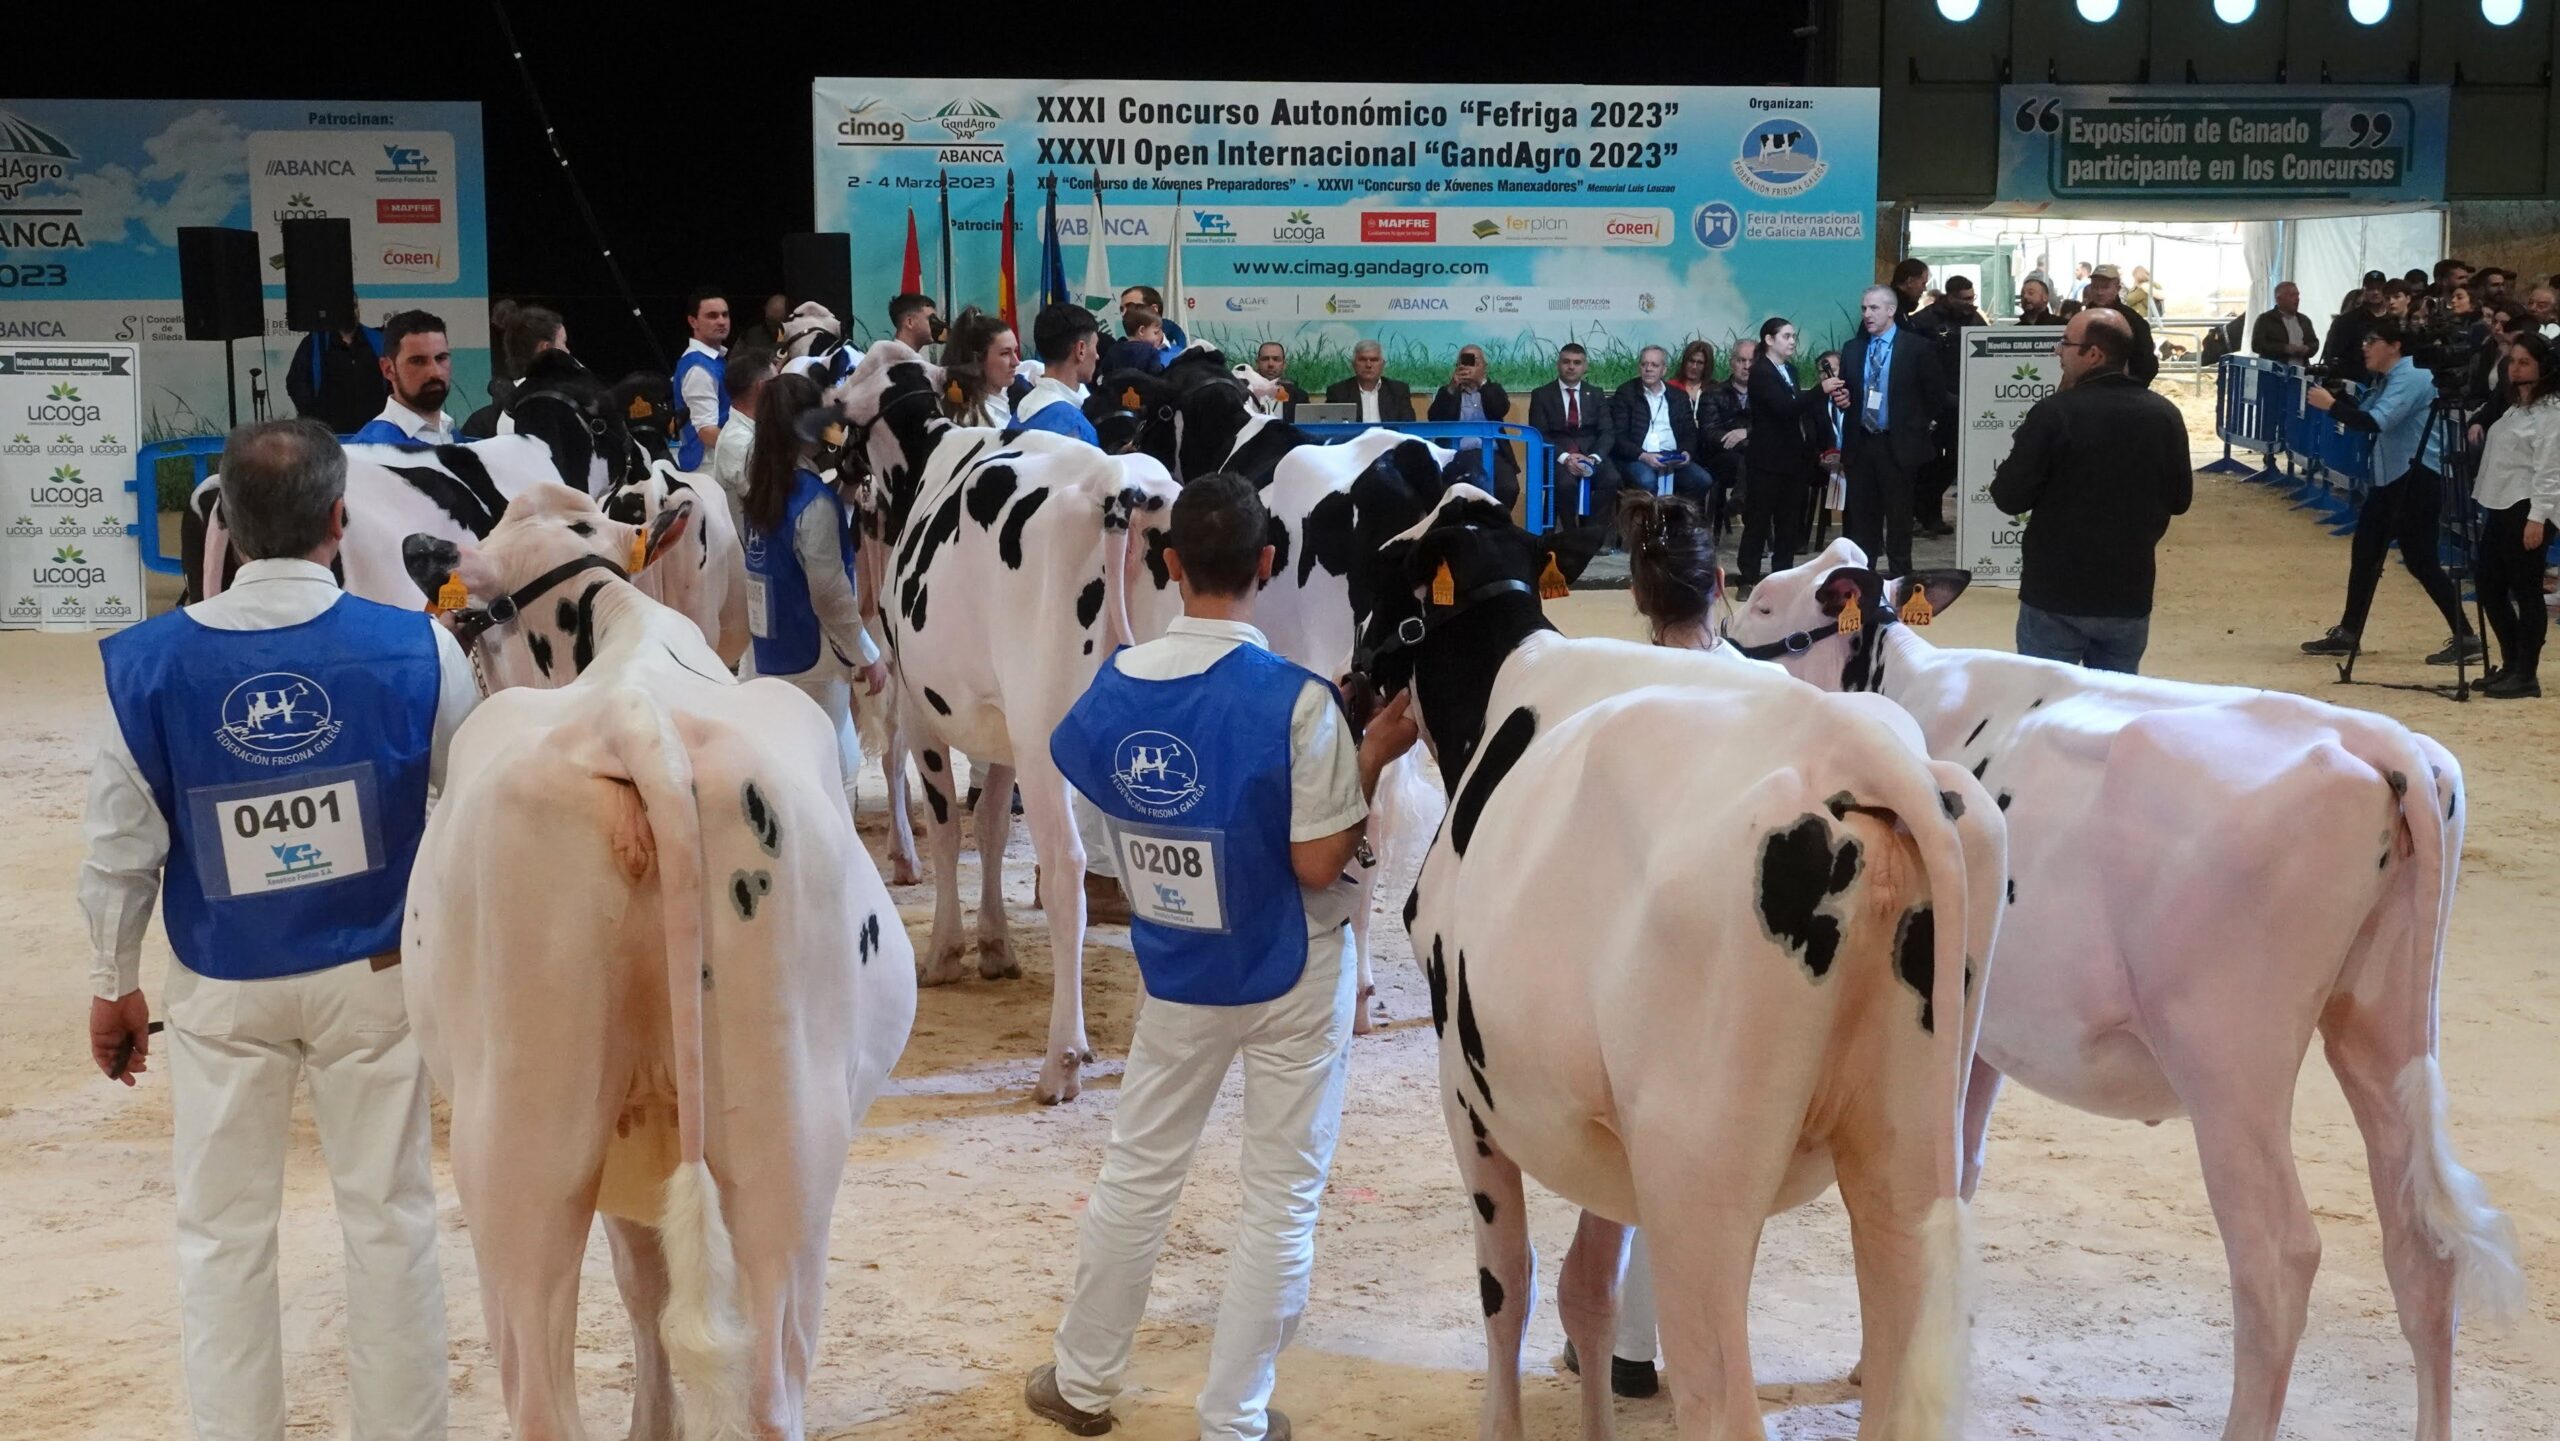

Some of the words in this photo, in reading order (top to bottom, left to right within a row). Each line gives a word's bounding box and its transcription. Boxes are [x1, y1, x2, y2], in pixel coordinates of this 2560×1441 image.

[1749, 97, 1814, 112] Organizan:
[308, 111, 395, 127] Patrocinan:
[1036, 96, 1106, 123] XXXI
[1119, 96, 1259, 125] Concurso
[1270, 96, 1448, 127] Autonómico
[1459, 100, 1578, 133] “Fefriga
[1590, 101, 1679, 128] 2023”
[837, 117, 905, 141] cimag
[941, 118, 996, 130] GandAgro
[2069, 114, 2187, 149] Exposición
[2194, 116, 2221, 144] de
[2228, 116, 2309, 145] Ganado
[938, 150, 1004, 163] ABANCA
[1036, 137, 1126, 165] XXXVI
[1134, 138, 1209, 171] Open
[1217, 140, 1416, 167] Internacional
[1425, 140, 1581, 174] “GandAgro
[1589, 142, 1678, 168] 2023”
[1733, 160, 1770, 195] FEDERACIÓN
[1771, 184, 1803, 196] FRISONA
[1805, 161, 1827, 188] GALEGA
[2067, 154, 2201, 187] participante
[2208, 159, 2235, 181] en
[2242, 154, 2275, 181] los
[2282, 153, 2395, 181] Concursos
[848, 176, 860, 188] 2
[878, 176, 890, 188] 4
[895, 176, 942, 188] Marzo
[949, 176, 996, 188] 2023
[1062, 176, 1128, 190] “Conurso
[1132, 176, 1148, 190] de
[1151, 176, 1203, 191] Xóvenes
[1317, 178, 1354, 191] XXXVI
[1425, 179, 1441, 192] de
[1444, 178, 1494, 193] Xóvenes
[1587, 183, 1627, 193] Memorial
[1627, 183, 1645, 193] Luis
[1646, 184, 1676, 193] Louzao
[1378, 218, 1430, 228] MAPFRE
[1506, 215, 1568, 234] ferplan
[1747, 213, 1777, 225] Feira
[1780, 213, 1860, 225] Internacional
[1273, 226, 1325, 244] ucoga
[1746, 226, 1762, 237] de
[1765, 226, 1806, 238] Galicia
[1809, 226, 1861, 237] ABANCA
[1233, 259, 1489, 279] www.cimag.gandagro.com
[161, 324, 173, 332] de
[2012, 341, 2033, 349] GRAN
[16, 357, 44, 367] Novilla
[46, 358, 69, 367] GRAN
[28, 405, 101, 427] ucoga
[1972, 419, 2004, 430] ucoga
[3, 444, 40, 456] ucoga
[47, 444, 84, 456] ucoga
[90, 444, 127, 456] ucoga
[31, 487, 104, 508] ucoga
[6, 526, 43, 538] ucoga
[49, 526, 86, 538] ucoga
[1991, 530, 2024, 545] uco
[33, 567, 106, 588] ucoga
[95, 606, 132, 618] ucoga
[1903, 612, 1930, 626] 4423
[1839, 617, 1860, 633] 4423
[213, 728, 270, 766] FEDERACIÓN
[272, 749, 315, 767] FRISONA
[314, 718, 344, 753] GALEGA
[1110, 773, 1147, 816] FEDERACIÓN
[1147, 808, 1179, 818] FRISONA
[1179, 784, 1207, 814] GALEGA
[234, 790, 341, 839] 0401
[1129, 840, 1203, 879] 0208
